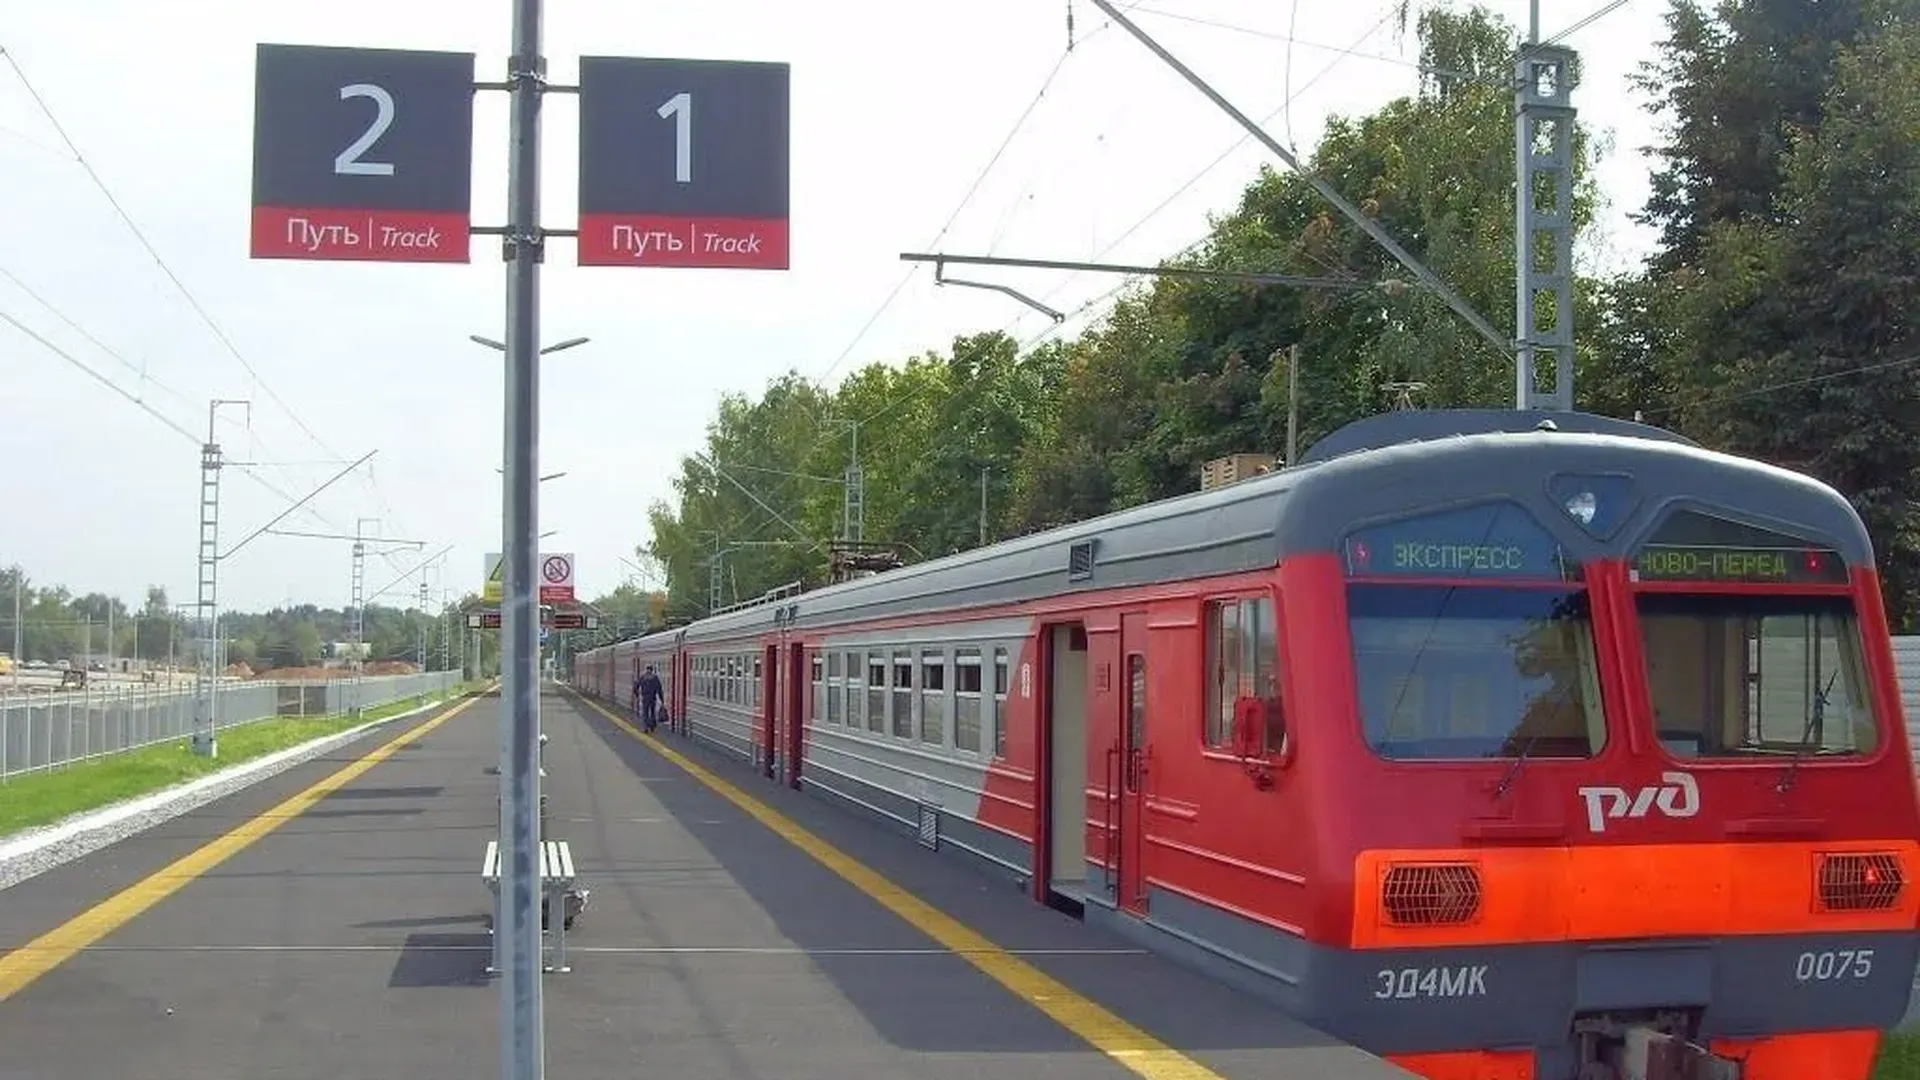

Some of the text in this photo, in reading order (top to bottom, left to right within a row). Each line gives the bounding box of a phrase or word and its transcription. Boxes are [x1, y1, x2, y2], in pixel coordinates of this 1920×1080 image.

[334, 84, 395, 176] 2
[656, 92, 692, 183] 1
[286, 217, 441, 251] Путь Track
[612, 224, 762, 257] Путь Track
[1394, 543, 1522, 569] ЭКСПРЕСС
[1375, 965, 1489, 999] ЭД4МК
[1796, 949, 1875, 981] 0075
